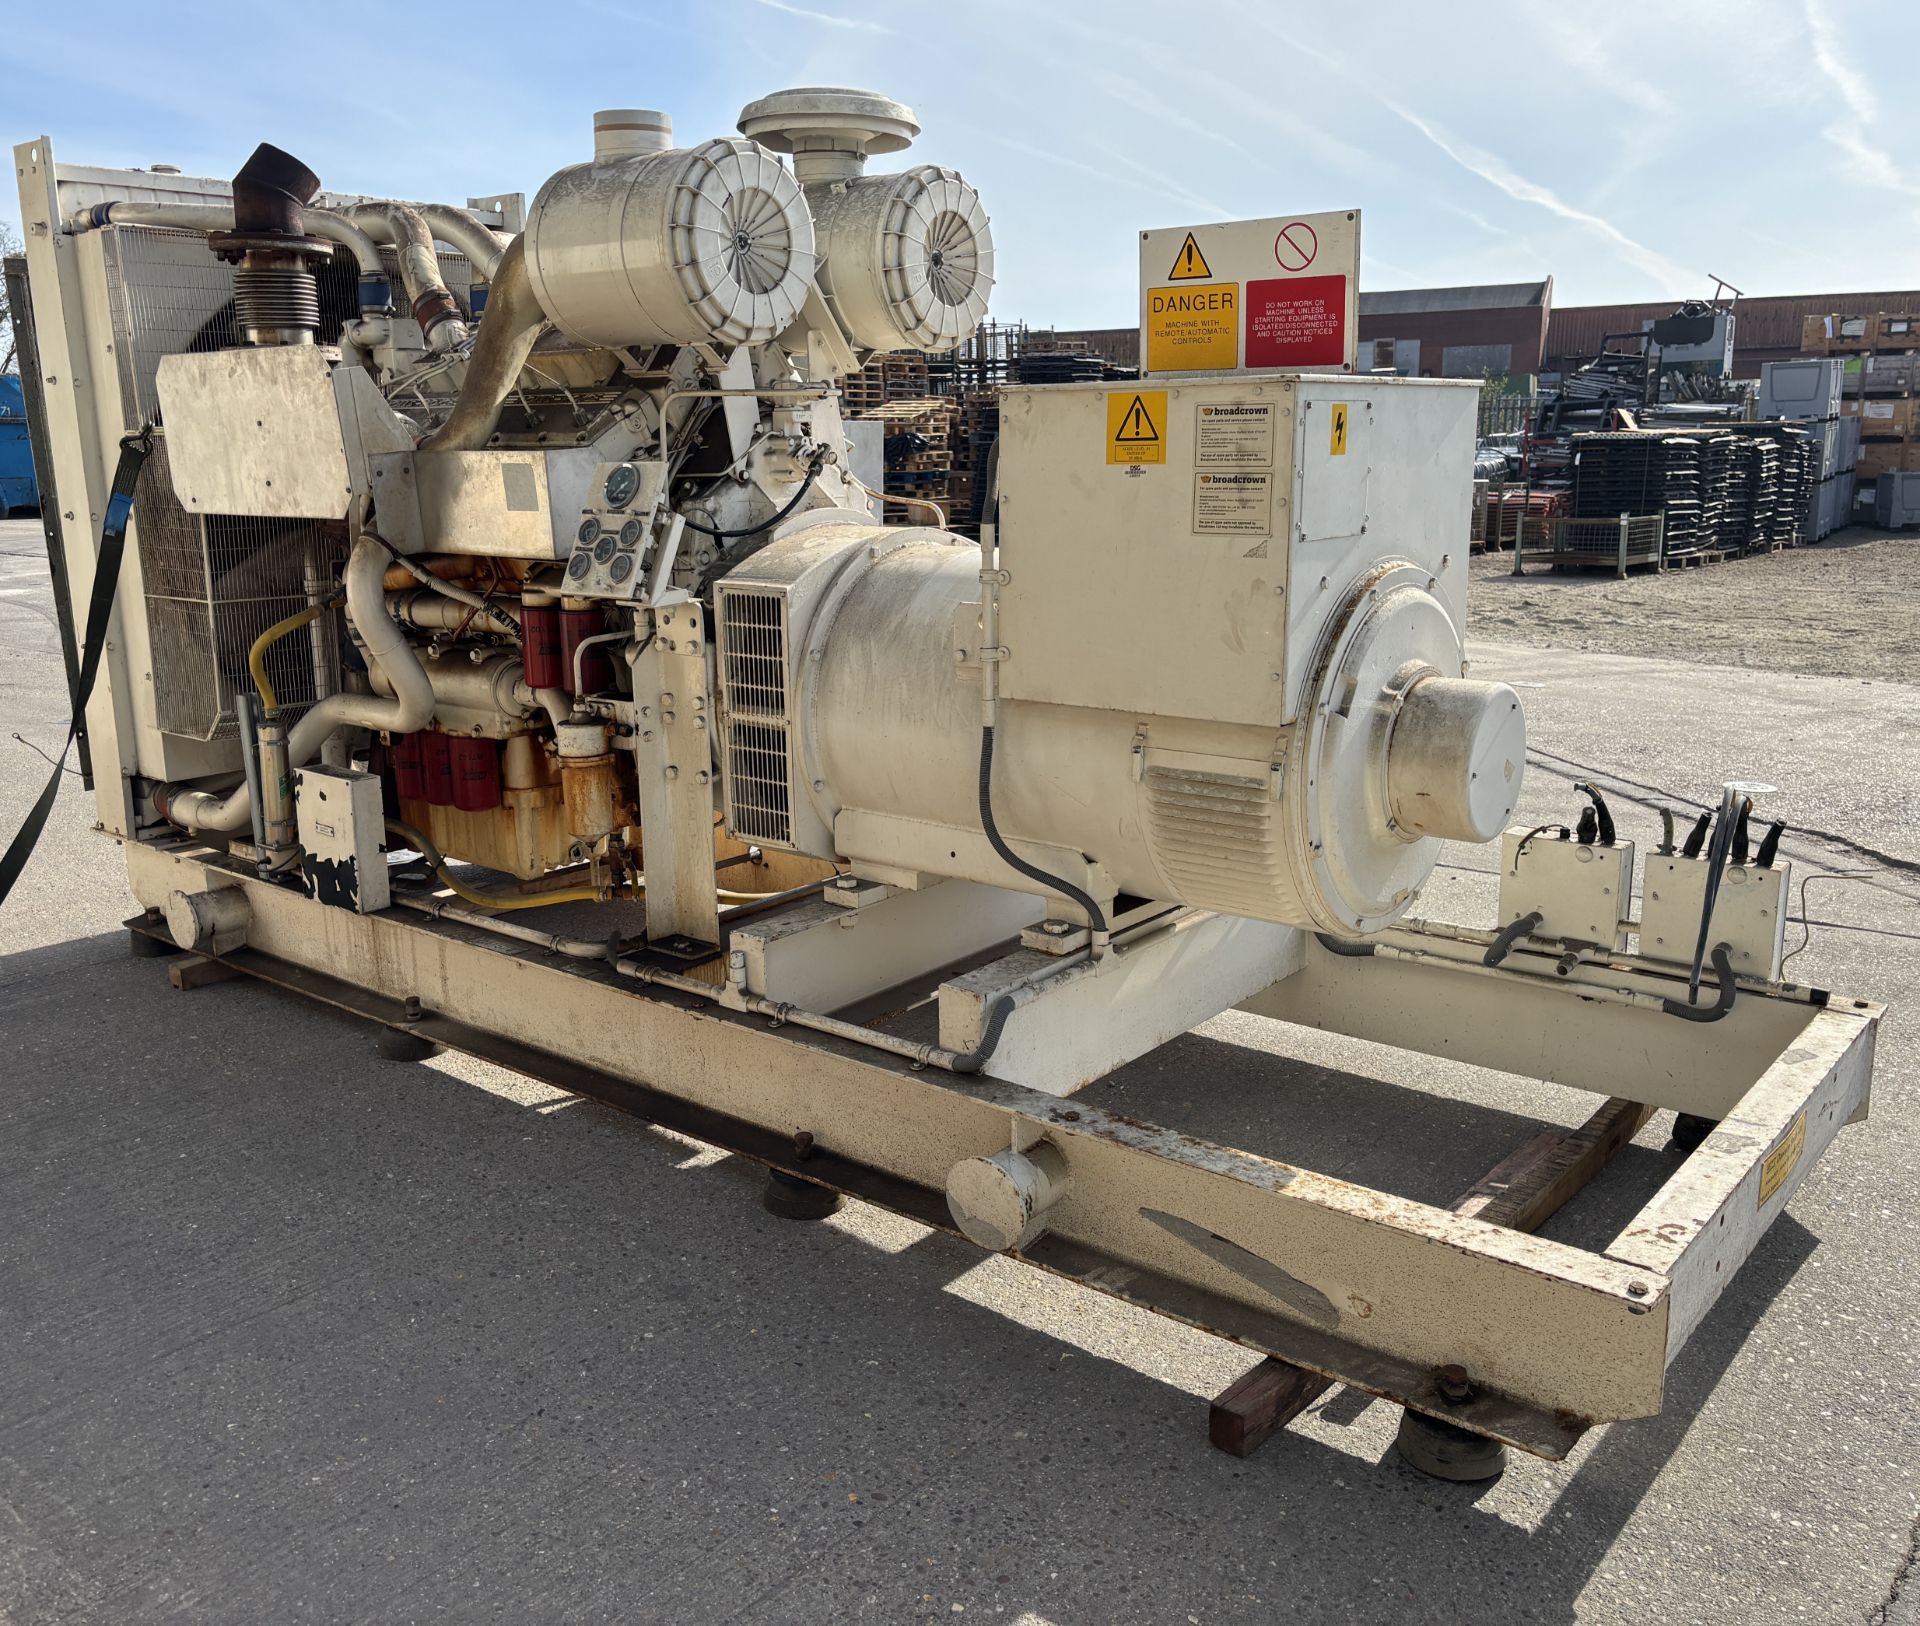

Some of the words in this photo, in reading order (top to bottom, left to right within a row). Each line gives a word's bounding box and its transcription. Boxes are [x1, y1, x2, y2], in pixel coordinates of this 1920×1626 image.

[1153, 292, 1233, 312] DANGER
[1289, 314, 1326, 322] EQUIPMENT
[1165, 320, 1198, 328] MACHINE
[1214, 406, 1268, 415] broadcrown
[1212, 475, 1266, 484] broadcrown
